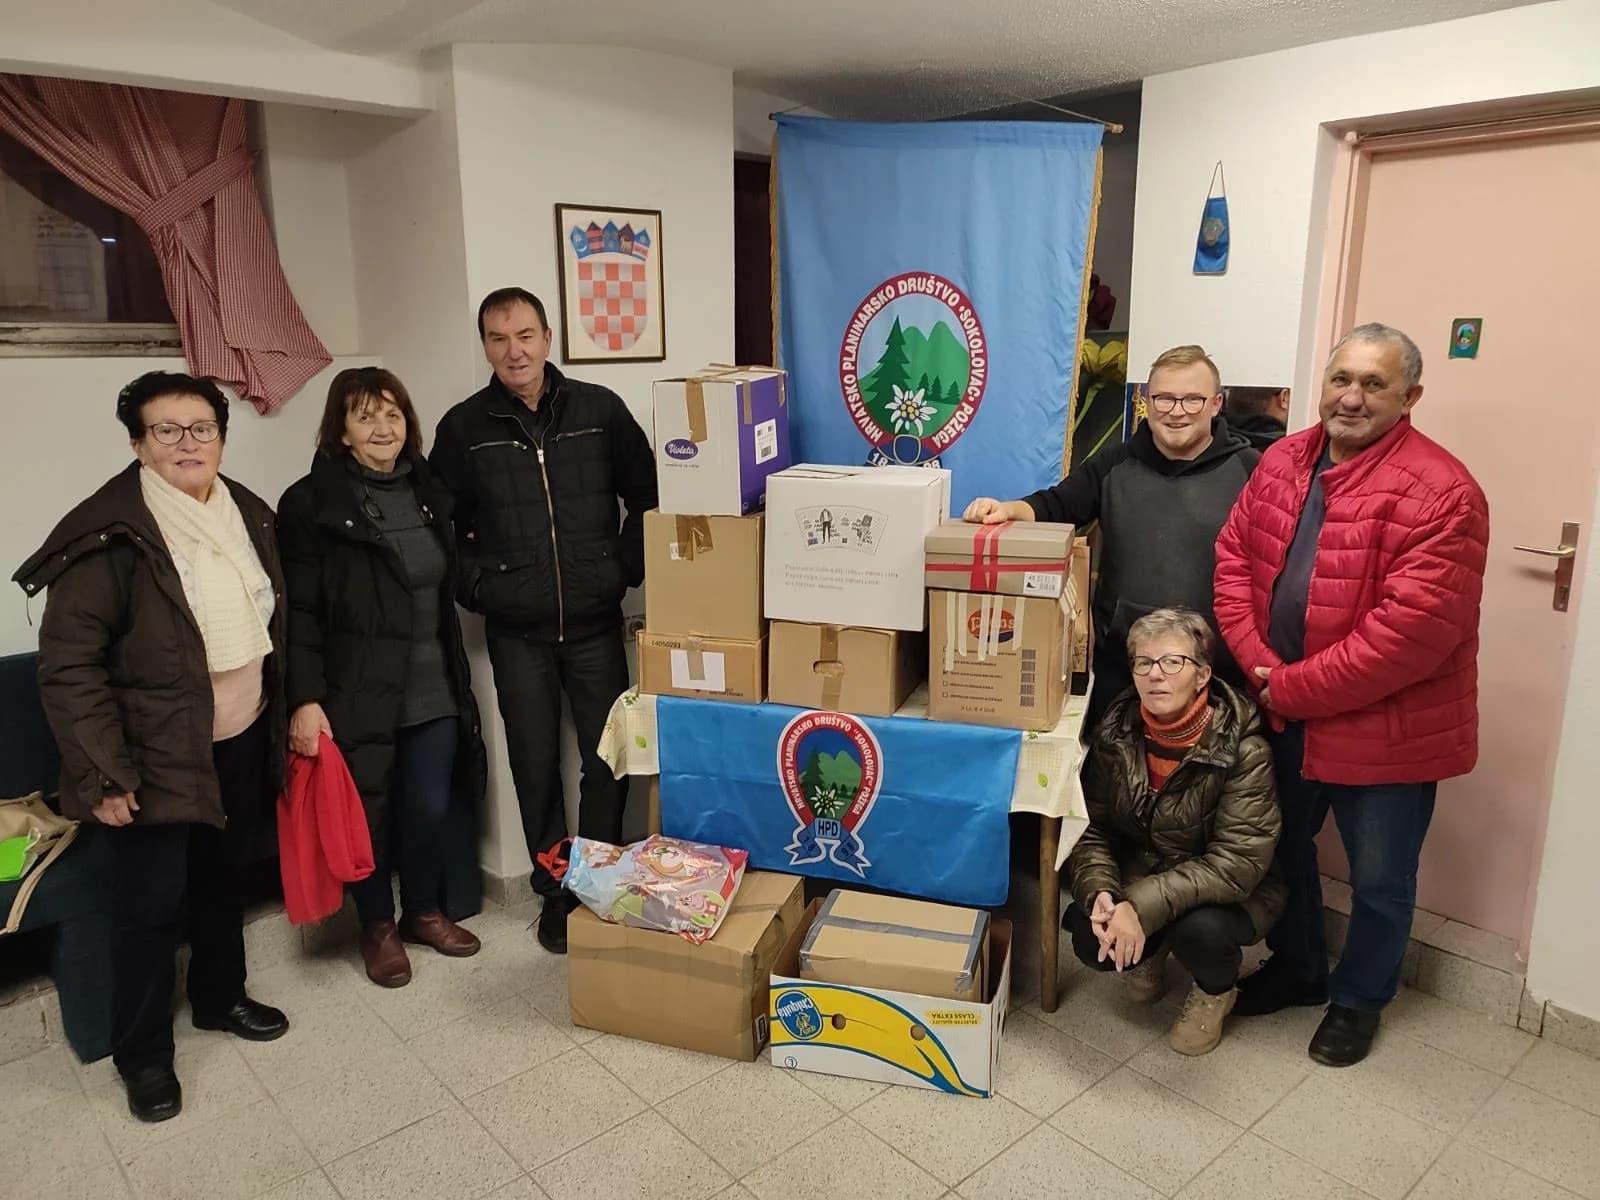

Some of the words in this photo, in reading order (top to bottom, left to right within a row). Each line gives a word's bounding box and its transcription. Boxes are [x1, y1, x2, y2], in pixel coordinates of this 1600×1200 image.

[897, 275, 960, 306] DRUŠTVO
[842, 284, 896, 371] PLANINARSKO
[843, 374, 883, 443] HRVATSKO
[931, 402, 974, 449] POŽEGA
[668, 443, 695, 456] Violeta
[814, 715, 851, 731] DRUŠTVO
[785, 717, 812, 767] PLANINARSKO
[786, 770, 805, 810] HRVATSKO
[817, 819, 839, 837] HPD
[777, 998, 814, 1017] Chiquita
